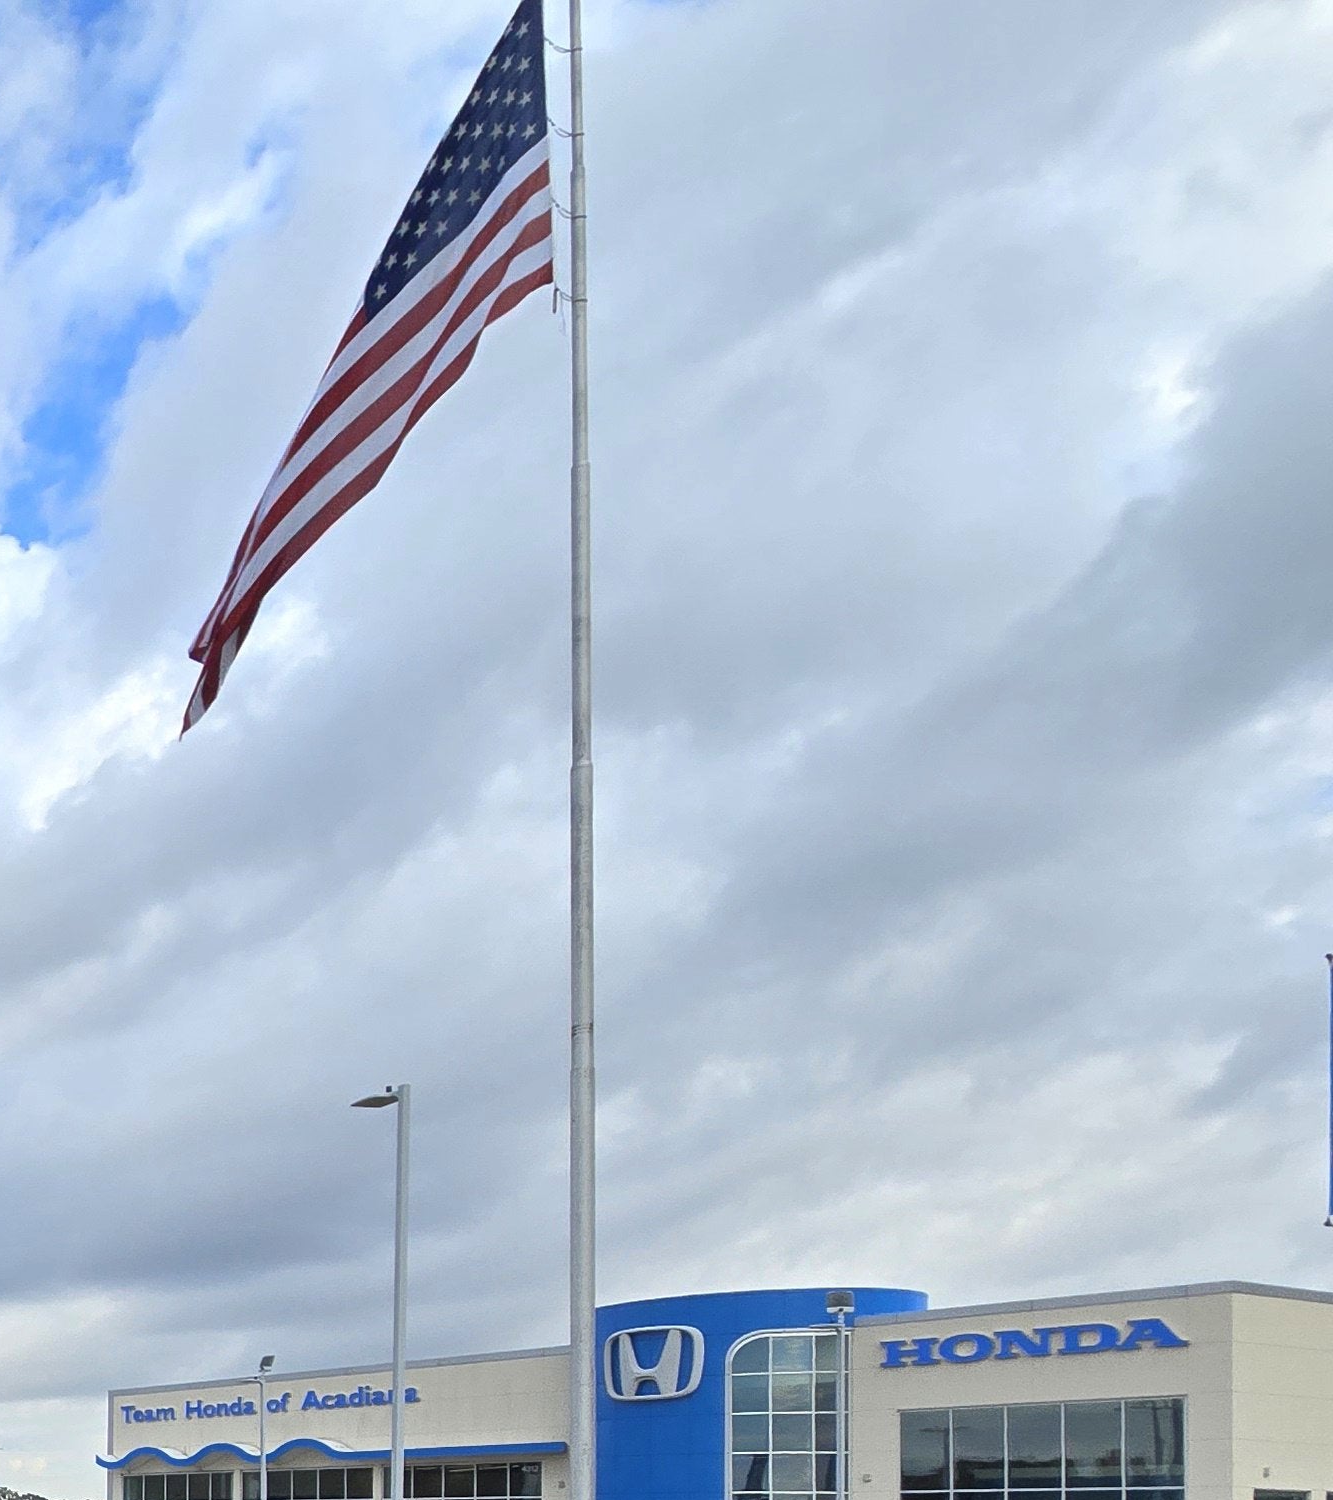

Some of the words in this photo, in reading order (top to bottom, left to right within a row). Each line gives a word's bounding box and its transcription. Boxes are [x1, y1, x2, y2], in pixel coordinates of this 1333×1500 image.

[879, 1318, 1190, 1368] HONDA
[121, 1405, 176, 1424] Team
[185, 1397, 257, 1420] Honda
[266, 1393, 292, 1413] of
